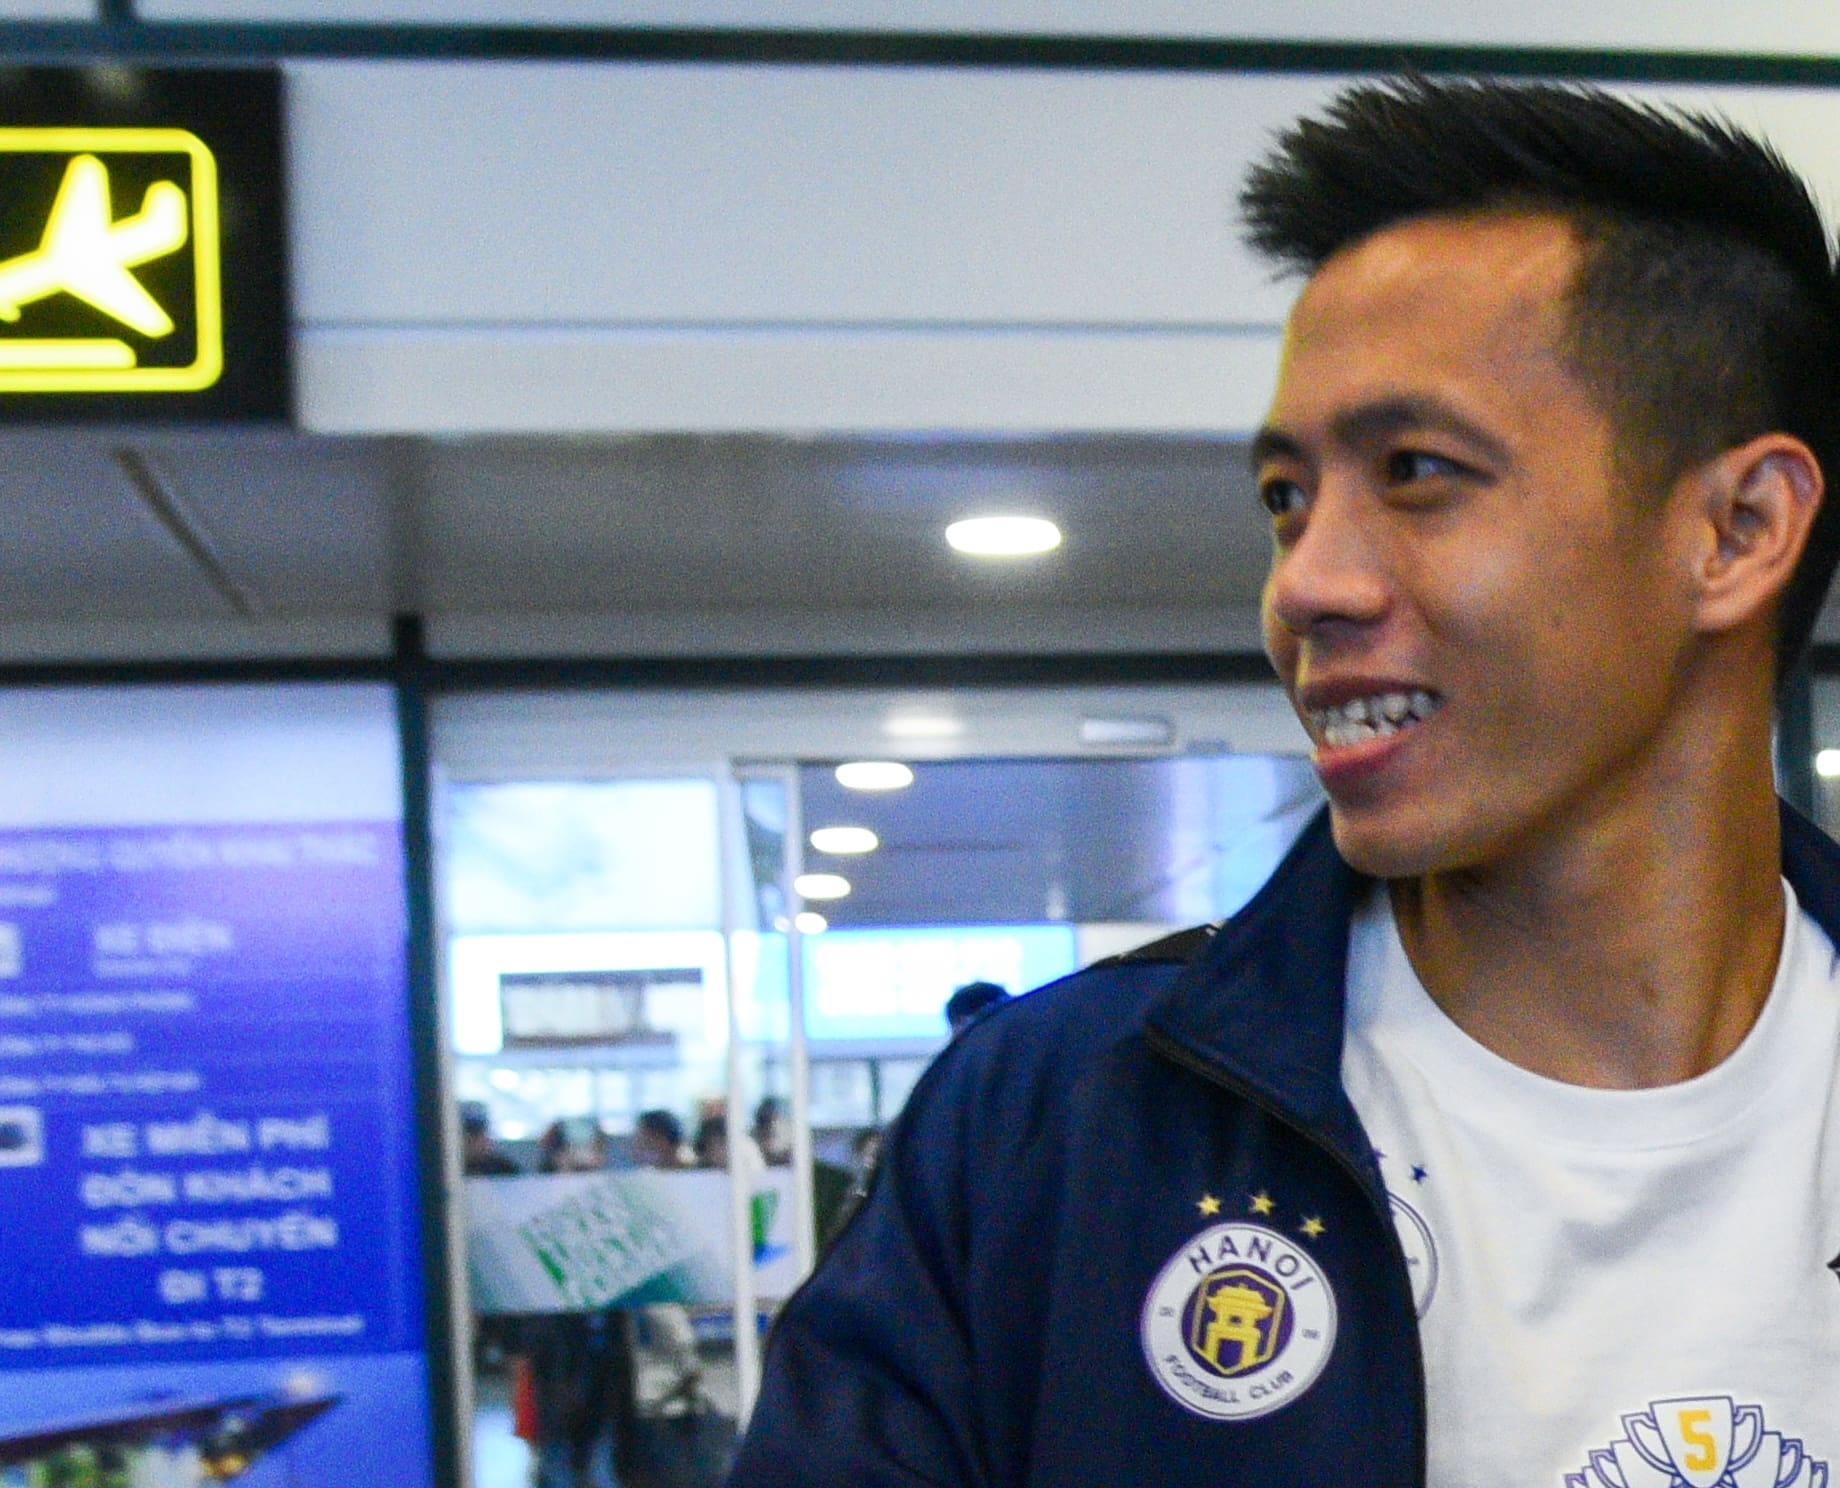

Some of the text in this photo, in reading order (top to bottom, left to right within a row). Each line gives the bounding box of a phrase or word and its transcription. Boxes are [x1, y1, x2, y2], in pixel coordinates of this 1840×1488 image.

[1189, 1234, 1314, 1291] HANOI
[1249, 1370, 1294, 1400] CLUB
[1679, 1409, 1717, 1473] 5
